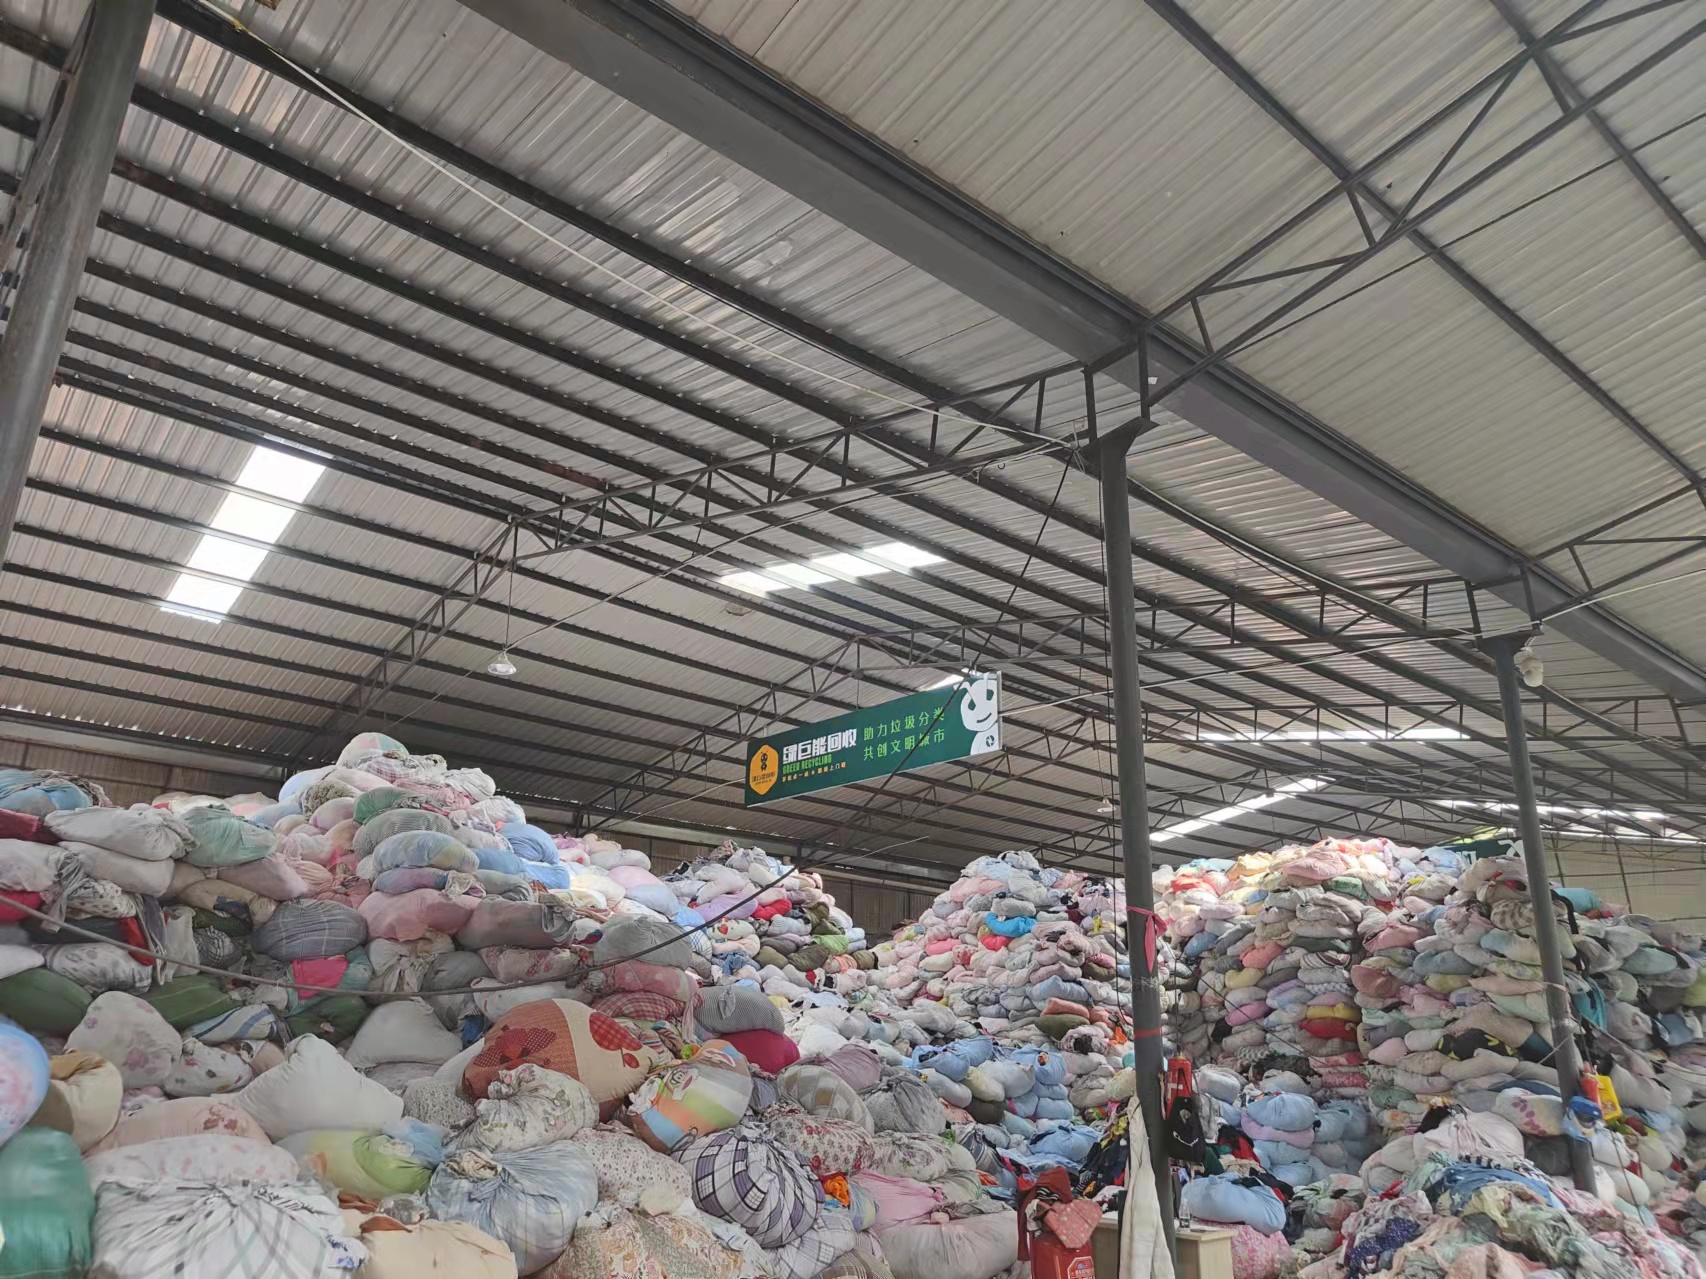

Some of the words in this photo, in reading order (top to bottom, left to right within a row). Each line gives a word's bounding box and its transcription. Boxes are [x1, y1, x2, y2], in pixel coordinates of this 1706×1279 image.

[864, 707, 944, 741] 助力垃圾分类
[783, 728, 857, 765] 绿巨能回收
[783, 762, 800, 775] GREEN
[801, 753, 832, 770] RECYCLING
